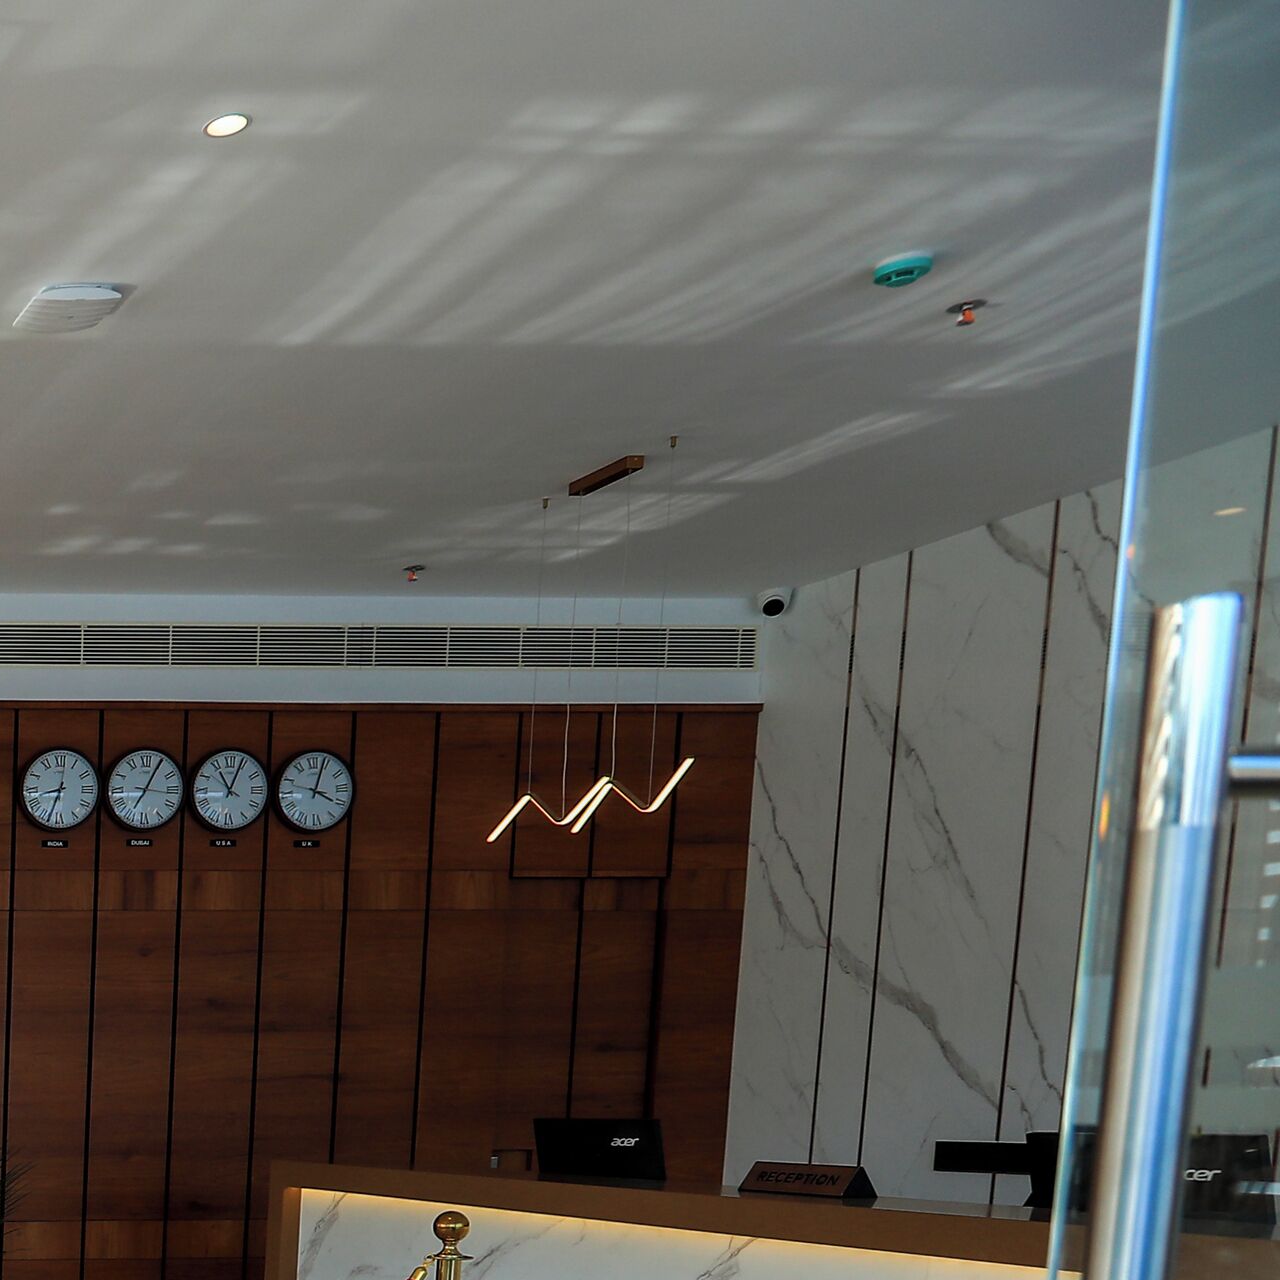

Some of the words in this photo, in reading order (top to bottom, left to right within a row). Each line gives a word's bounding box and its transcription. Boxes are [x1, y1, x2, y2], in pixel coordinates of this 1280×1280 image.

[610, 1137, 640, 1147] acer
[756, 1171, 841, 1187] RECEPTION
[1183, 1169, 1222, 1181] cer
